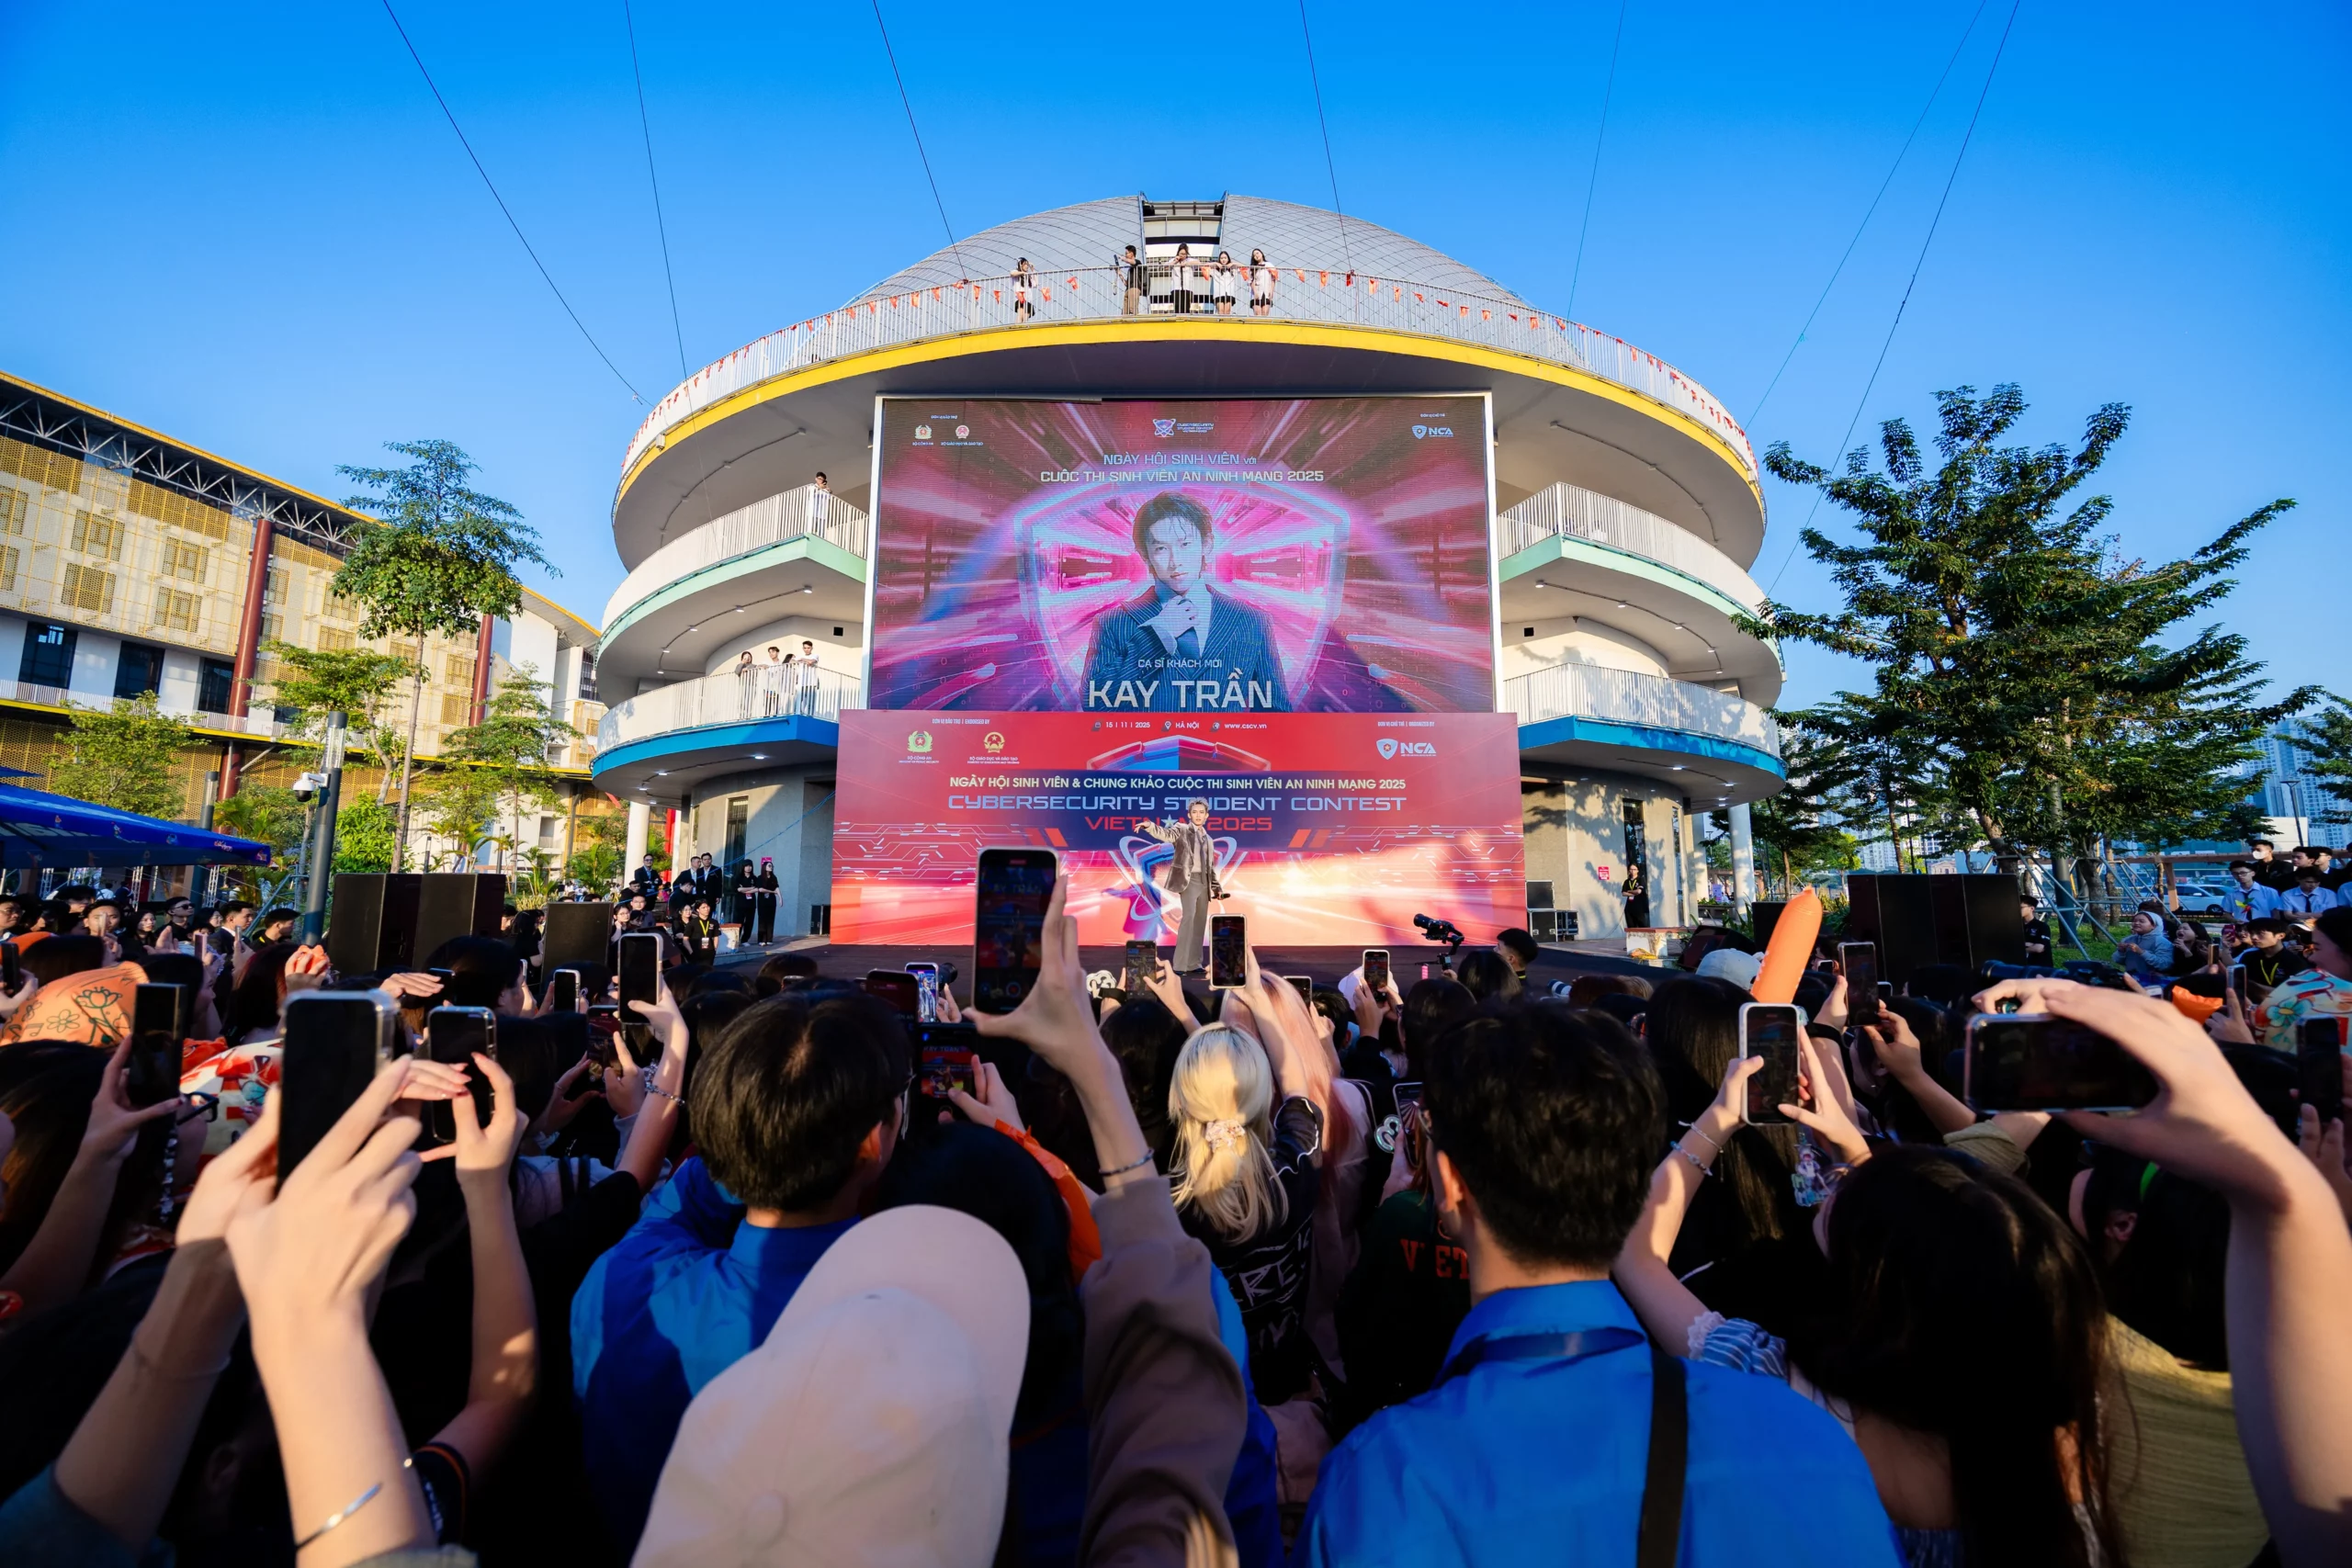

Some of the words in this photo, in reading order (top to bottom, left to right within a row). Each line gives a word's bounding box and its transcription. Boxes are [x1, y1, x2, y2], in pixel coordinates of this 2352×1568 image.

[1428, 426, 1453, 435] NCA
[1103, 452, 1140, 465] NGÀY
[1144, 451, 1167, 467] HỘI
[1171, 454, 1204, 465] SINH
[1207, 451, 1239, 465] VIÊN
[1040, 468, 1080, 484] CUỘC
[1082, 470, 1105, 482] THI
[1109, 470, 1142, 482] SINH
[1146, 468, 1178, 482] VIÊN
[1182, 470, 1201, 482] AN
[1205, 470, 1238, 482] NINH
[1287, 469, 1324, 482] 2025
[1167, 658, 1202, 668] KHÁCH
[1089, 680, 1159, 708] KAY
[1171, 667, 1272, 708] TRẦN
[1175, 720, 1185, 728] HÀ
[1186, 720, 1200, 730] NỘI
[1400, 742, 1437, 754] NCA
[950, 774, 986, 787] NGÀY
[989, 775, 1010, 790] HỘI
[1012, 777, 1039, 787] SINH
[1043, 776, 1069, 788] VIÊN
[1072, 778, 1080, 788] &
[1083, 778, 1127, 788] CHUNG
[1130, 775, 1164, 788] KHẢO
[1168, 777, 1204, 791] CUỘC
[1206, 779, 1223, 789] THI
[1226, 779, 1252, 789] SINH
[1256, 777, 1282, 789] VIÊN
[1285, 779, 1303, 789] AN
[1306, 779, 1335, 789] NINH
[1338, 779, 1376, 792] MẠNG
[1379, 779, 1406, 789] 2025
[948, 795, 1155, 810] CYBERSECURITY
[1291, 797, 1407, 811] CONTEST
[1207, 818, 1272, 831] 2025
